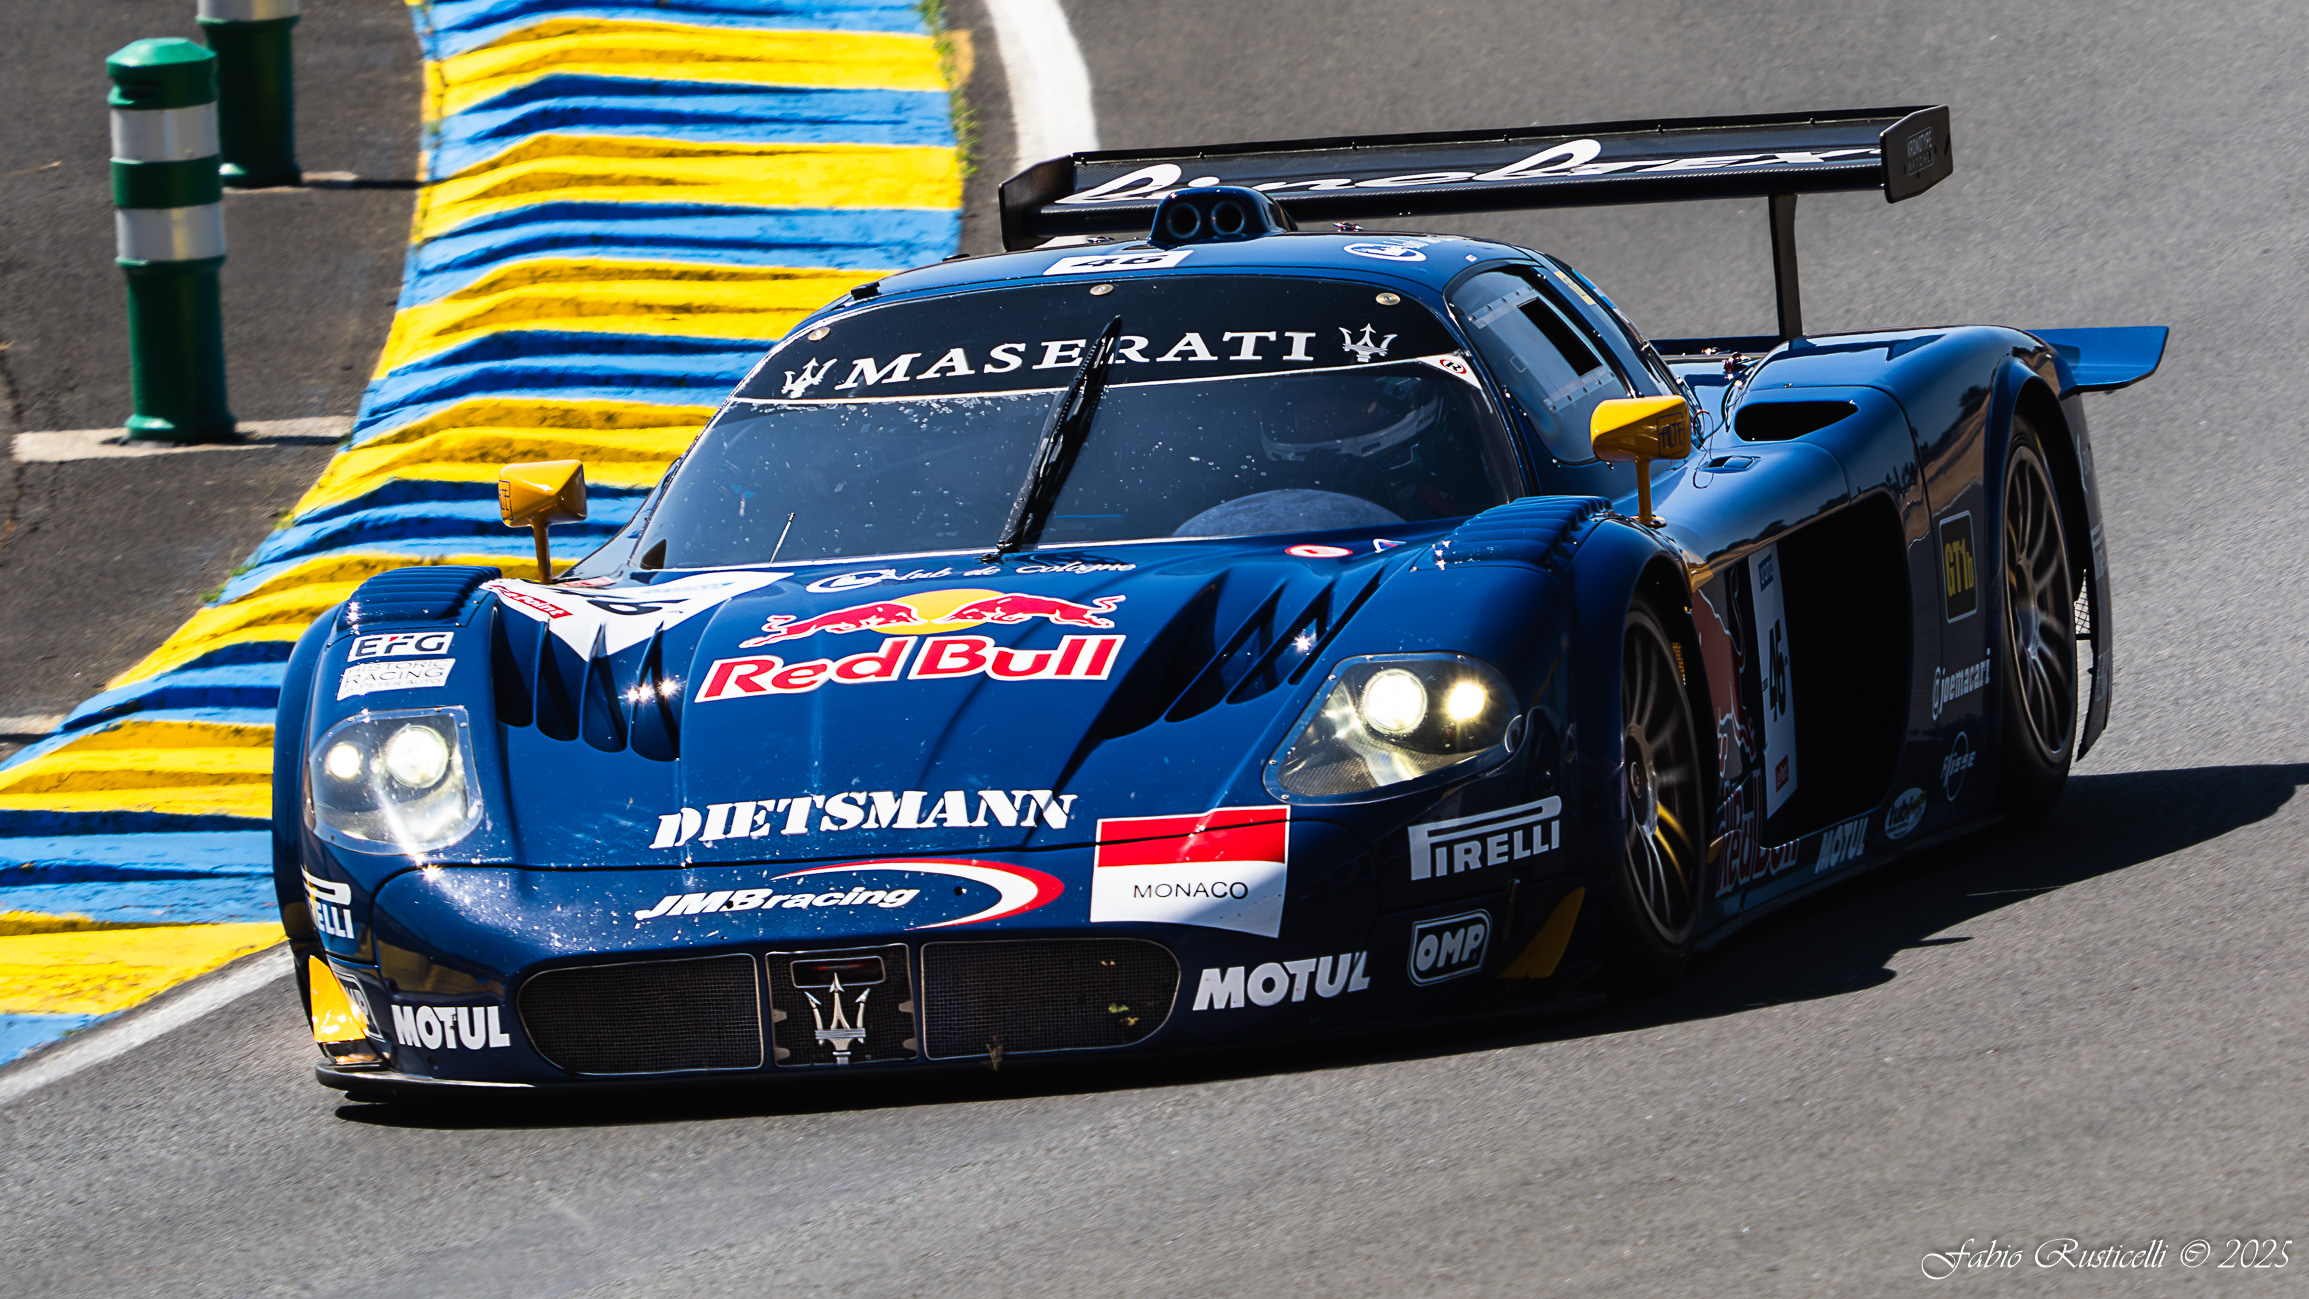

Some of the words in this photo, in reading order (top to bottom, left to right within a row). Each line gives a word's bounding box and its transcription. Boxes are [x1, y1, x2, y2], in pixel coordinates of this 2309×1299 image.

[1074, 252, 1167, 267] 46
[835, 331, 1316, 391] MASERATI
[963, 565, 1000, 577] de
[1945, 538, 1975, 597] GT1b
[355, 635, 447, 657] EFG
[695, 640, 912, 703] Red
[908, 634, 1127, 681] Bull
[344, 668, 443, 688] RACING
[650, 789, 1076, 850] DIETSMANN
[1408, 795, 1562, 880] PIRELLI
[1814, 817, 1869, 874] MOTUL
[1133, 881, 1249, 900] MONACO
[1416, 924, 1487, 972] OMP
[1193, 950, 1371, 1010] MOTUL
[391, 1003, 511, 1050] MOTUL
